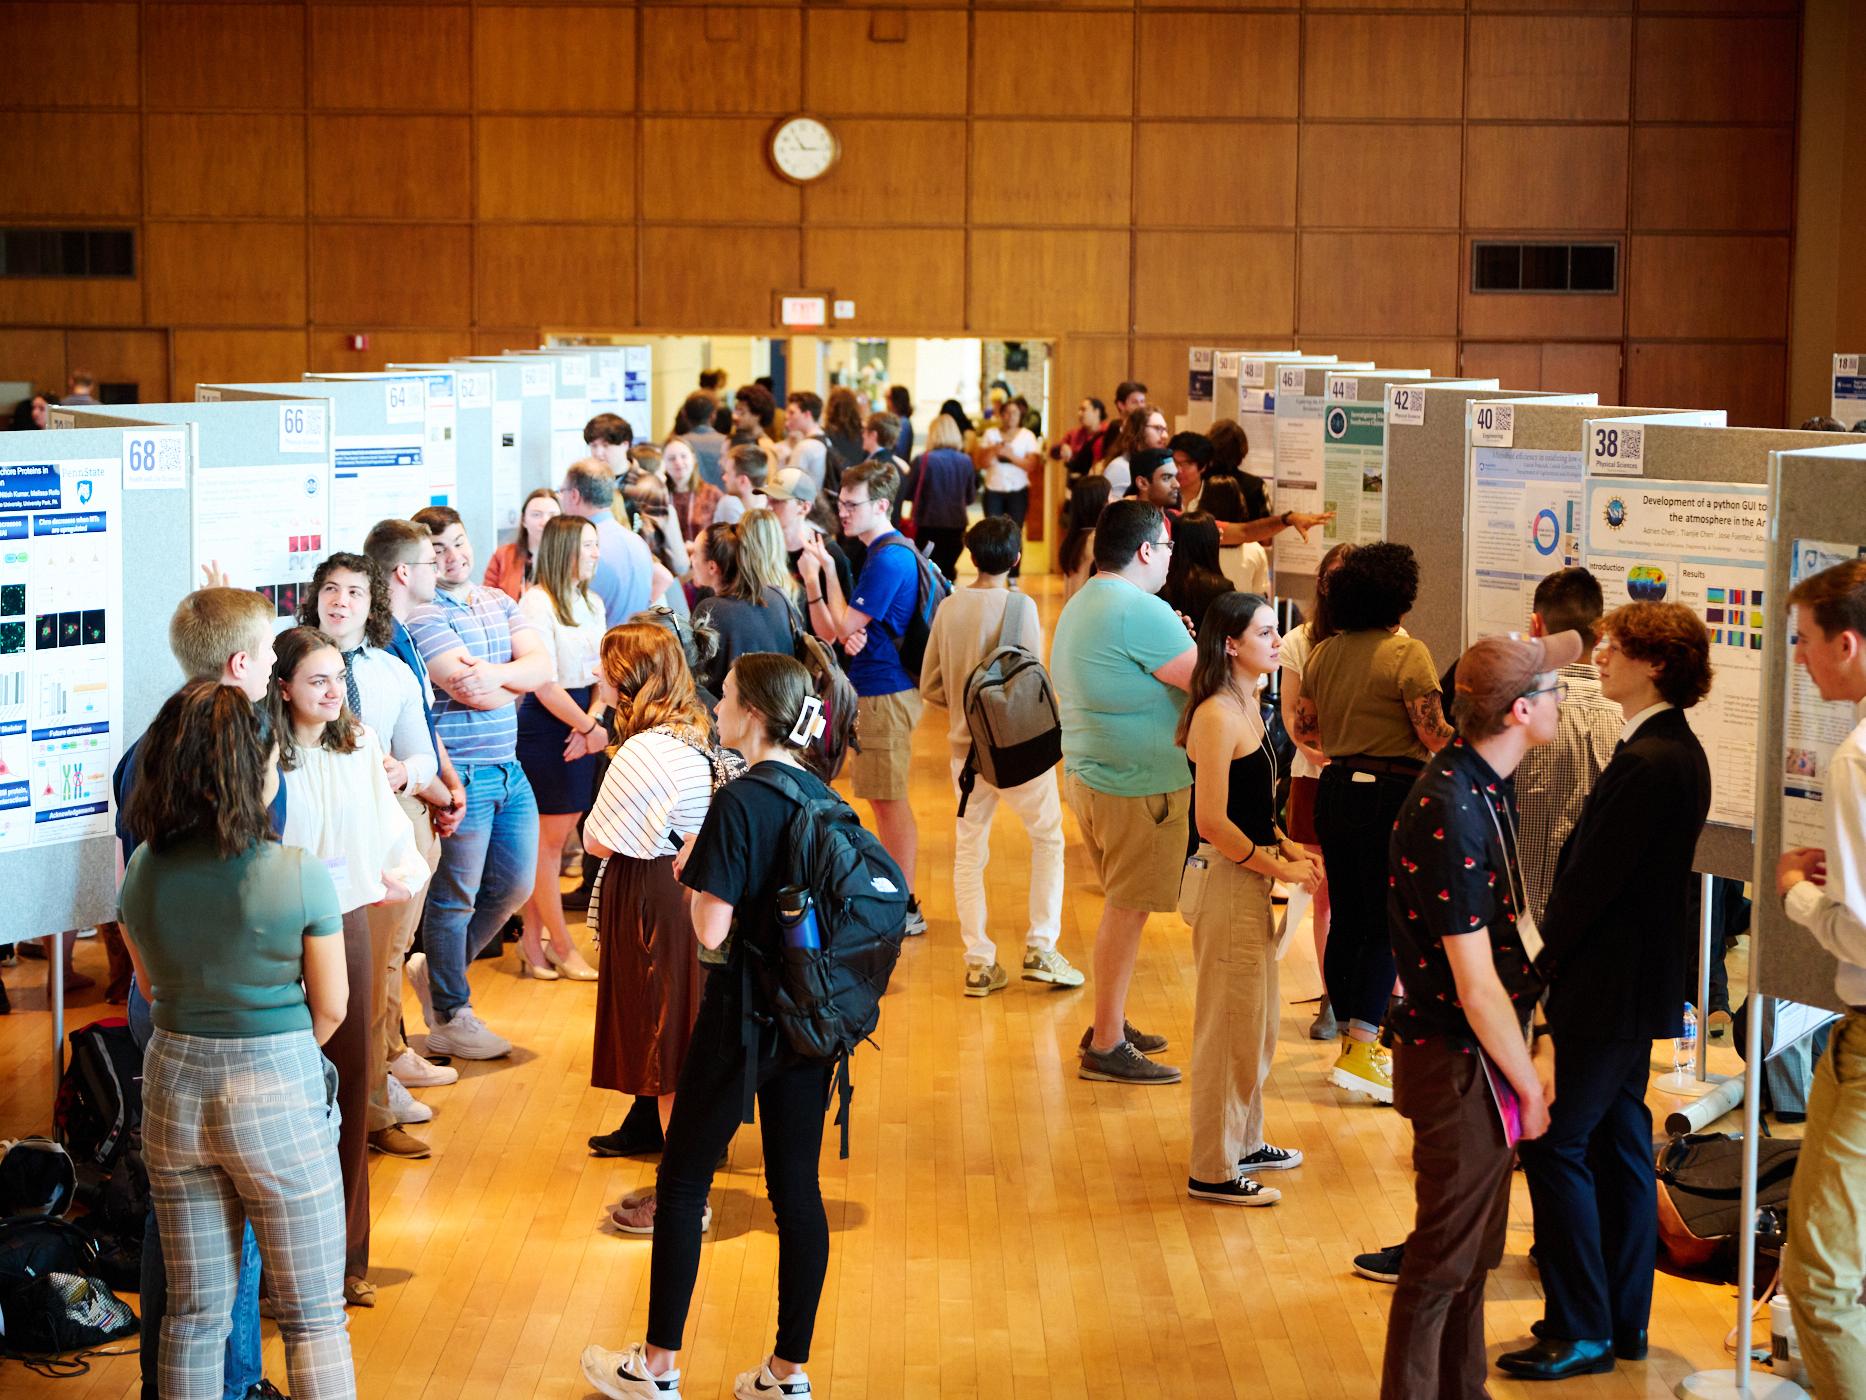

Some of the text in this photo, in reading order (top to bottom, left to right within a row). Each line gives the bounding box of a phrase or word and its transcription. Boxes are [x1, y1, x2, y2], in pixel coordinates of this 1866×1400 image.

[1219, 357, 1228, 369] 50
[1244, 363, 1254, 377] 48
[1839, 357, 1848, 370] 18
[1282, 371, 1293, 387] 46
[462, 378, 474, 398] 62
[1332, 381, 1345, 398] 44
[390, 386, 405, 408] 64
[1394, 390, 1409, 410] 42
[284, 408, 304, 434] 66
[1477, 408, 1493, 430] 40
[1595, 428, 1618, 457] 38
[129, 439, 156, 472] 68
[17, 466, 42, 475] Proteins
[42, 466, 49, 474] in
[1642, 495, 1768, 511] Development of a python GUI to
[1669, 513, 1767, 527] the atmosphere in the Ar
[1682, 569, 1705, 579] Results
[49, 726, 92, 738] Future directions
[792, 1383, 809, 1393] NIKE
